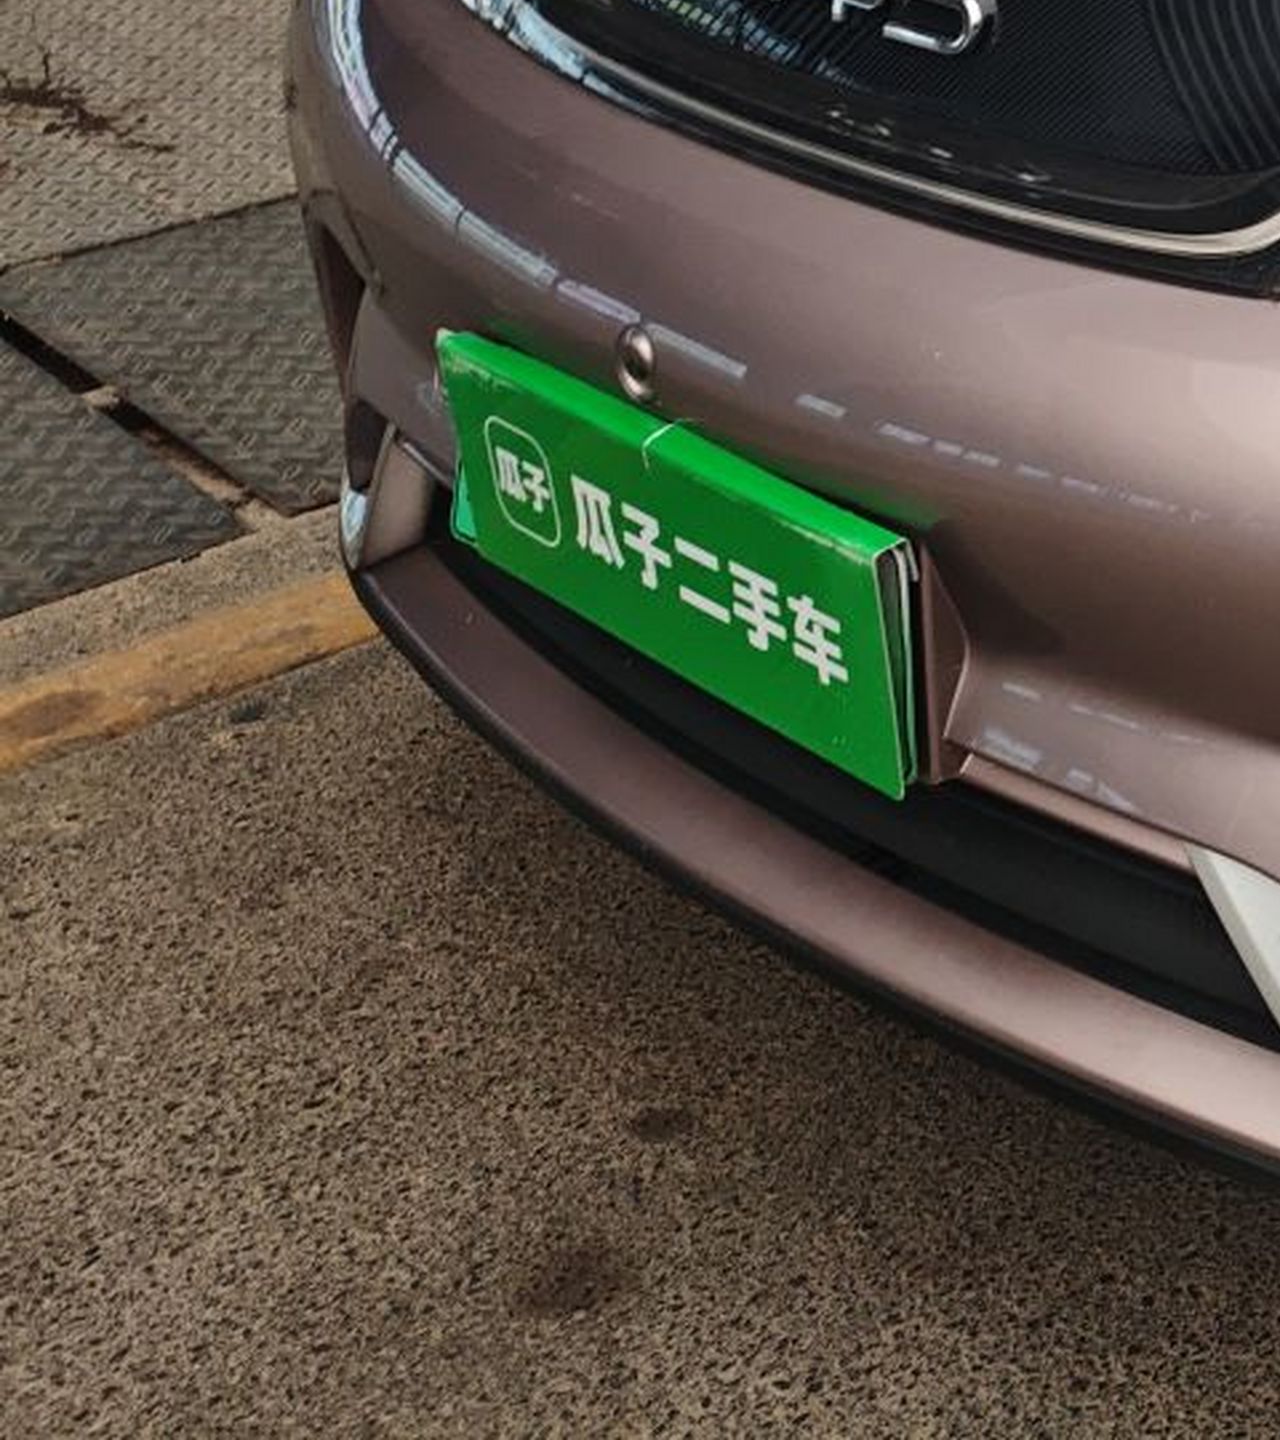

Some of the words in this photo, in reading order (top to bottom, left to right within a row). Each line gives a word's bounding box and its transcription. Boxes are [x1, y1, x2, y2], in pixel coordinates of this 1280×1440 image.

[495, 446, 553, 513] 瓜子
[571, 474, 850, 686] 瓜子二手车
